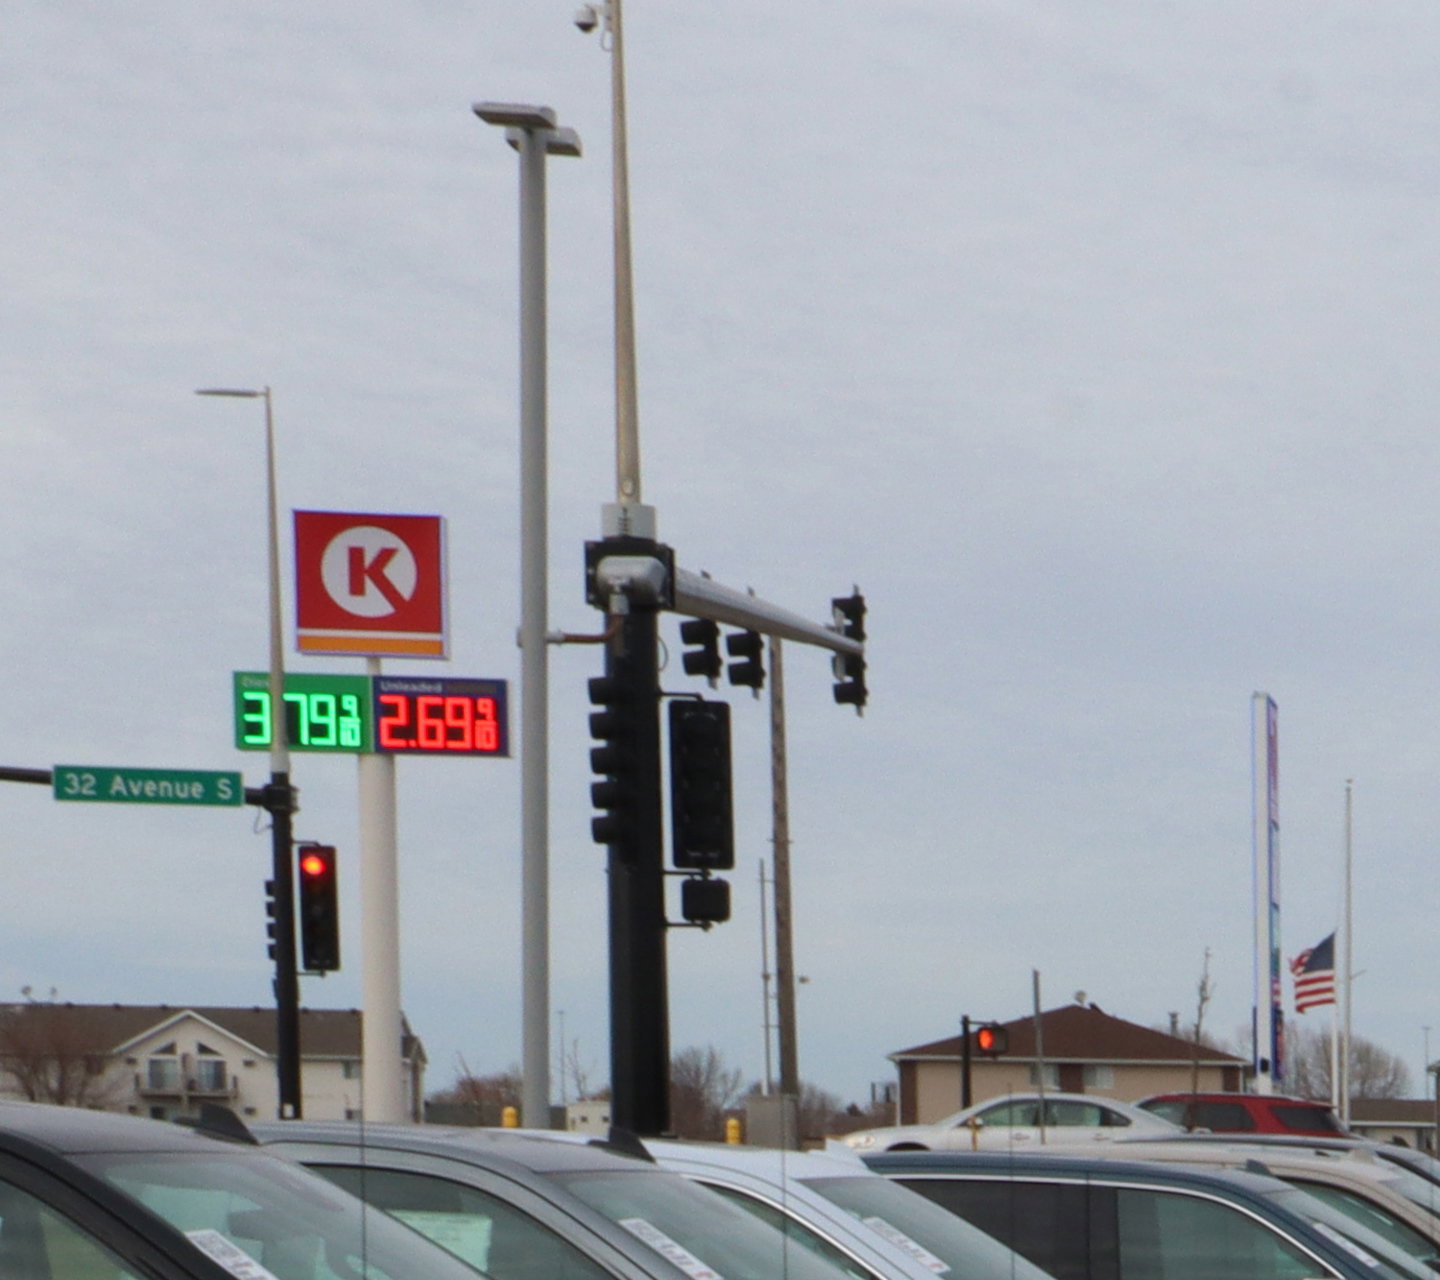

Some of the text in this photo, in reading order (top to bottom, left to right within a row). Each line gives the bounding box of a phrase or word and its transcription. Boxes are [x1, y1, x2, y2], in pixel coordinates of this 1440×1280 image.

[380, 680, 443, 693] Unleaded
[64, 772, 233, 800] 32 Avenue S
